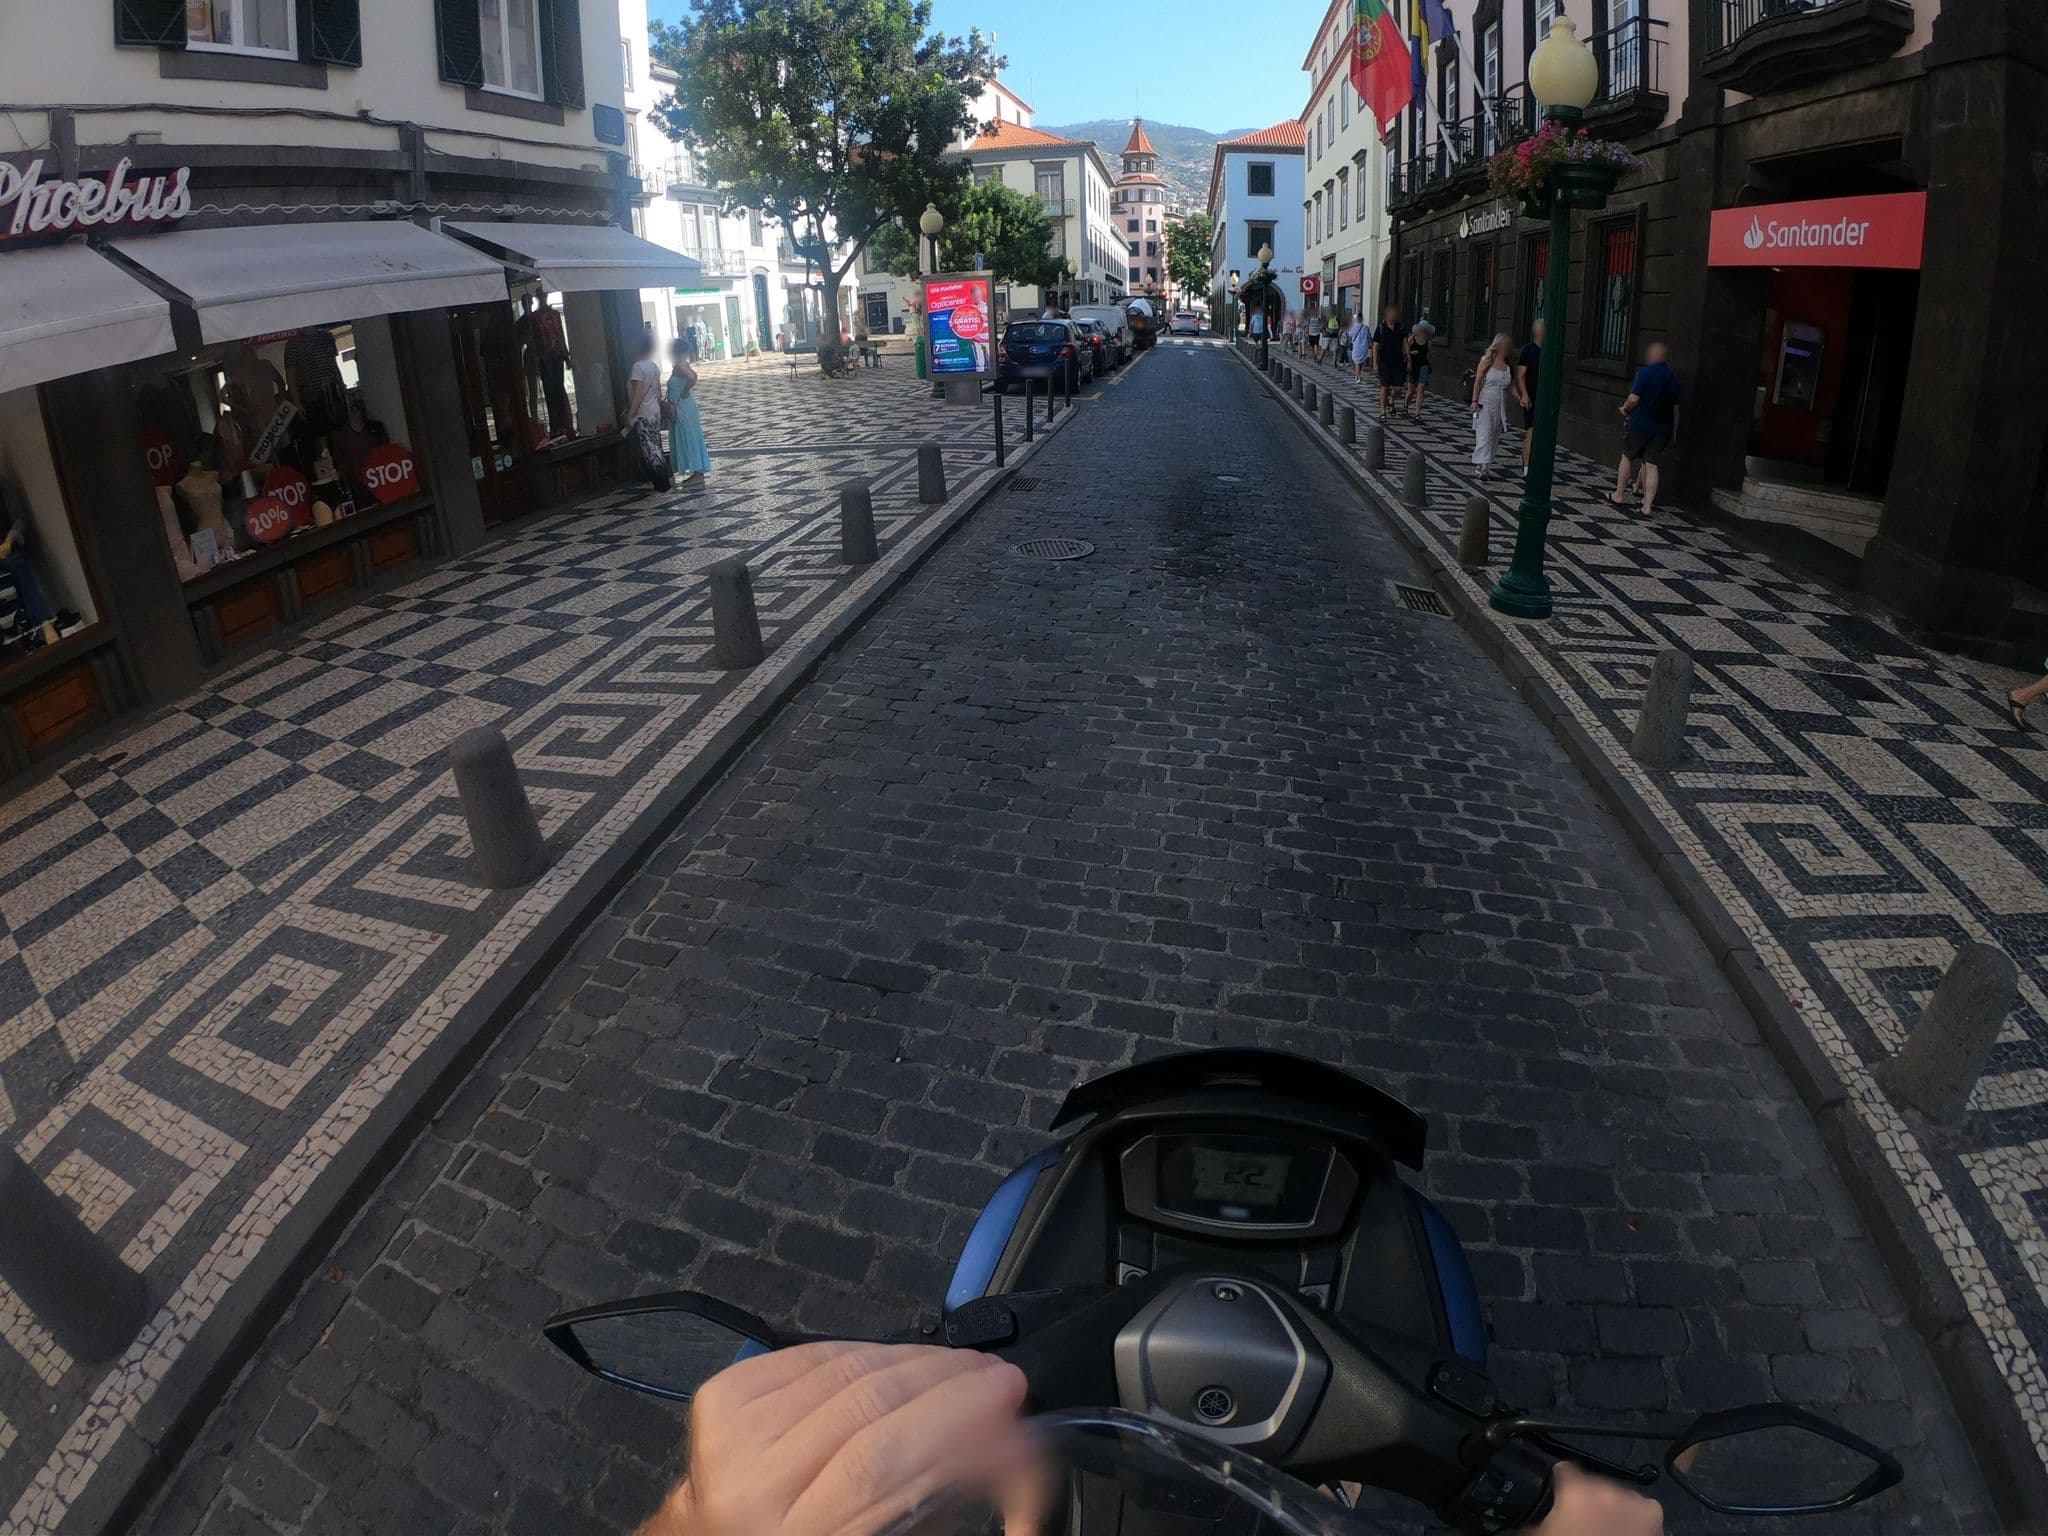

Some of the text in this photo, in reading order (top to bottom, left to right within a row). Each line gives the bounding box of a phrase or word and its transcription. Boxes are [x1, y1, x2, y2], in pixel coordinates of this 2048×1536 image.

[0, 156, 191, 234] Phoebus
[1469, 199, 1511, 236] Santander
[1767, 216, 1869, 248] Santander
[365, 458, 414, 490] STOP
[249, 505, 288, 536] 20%
